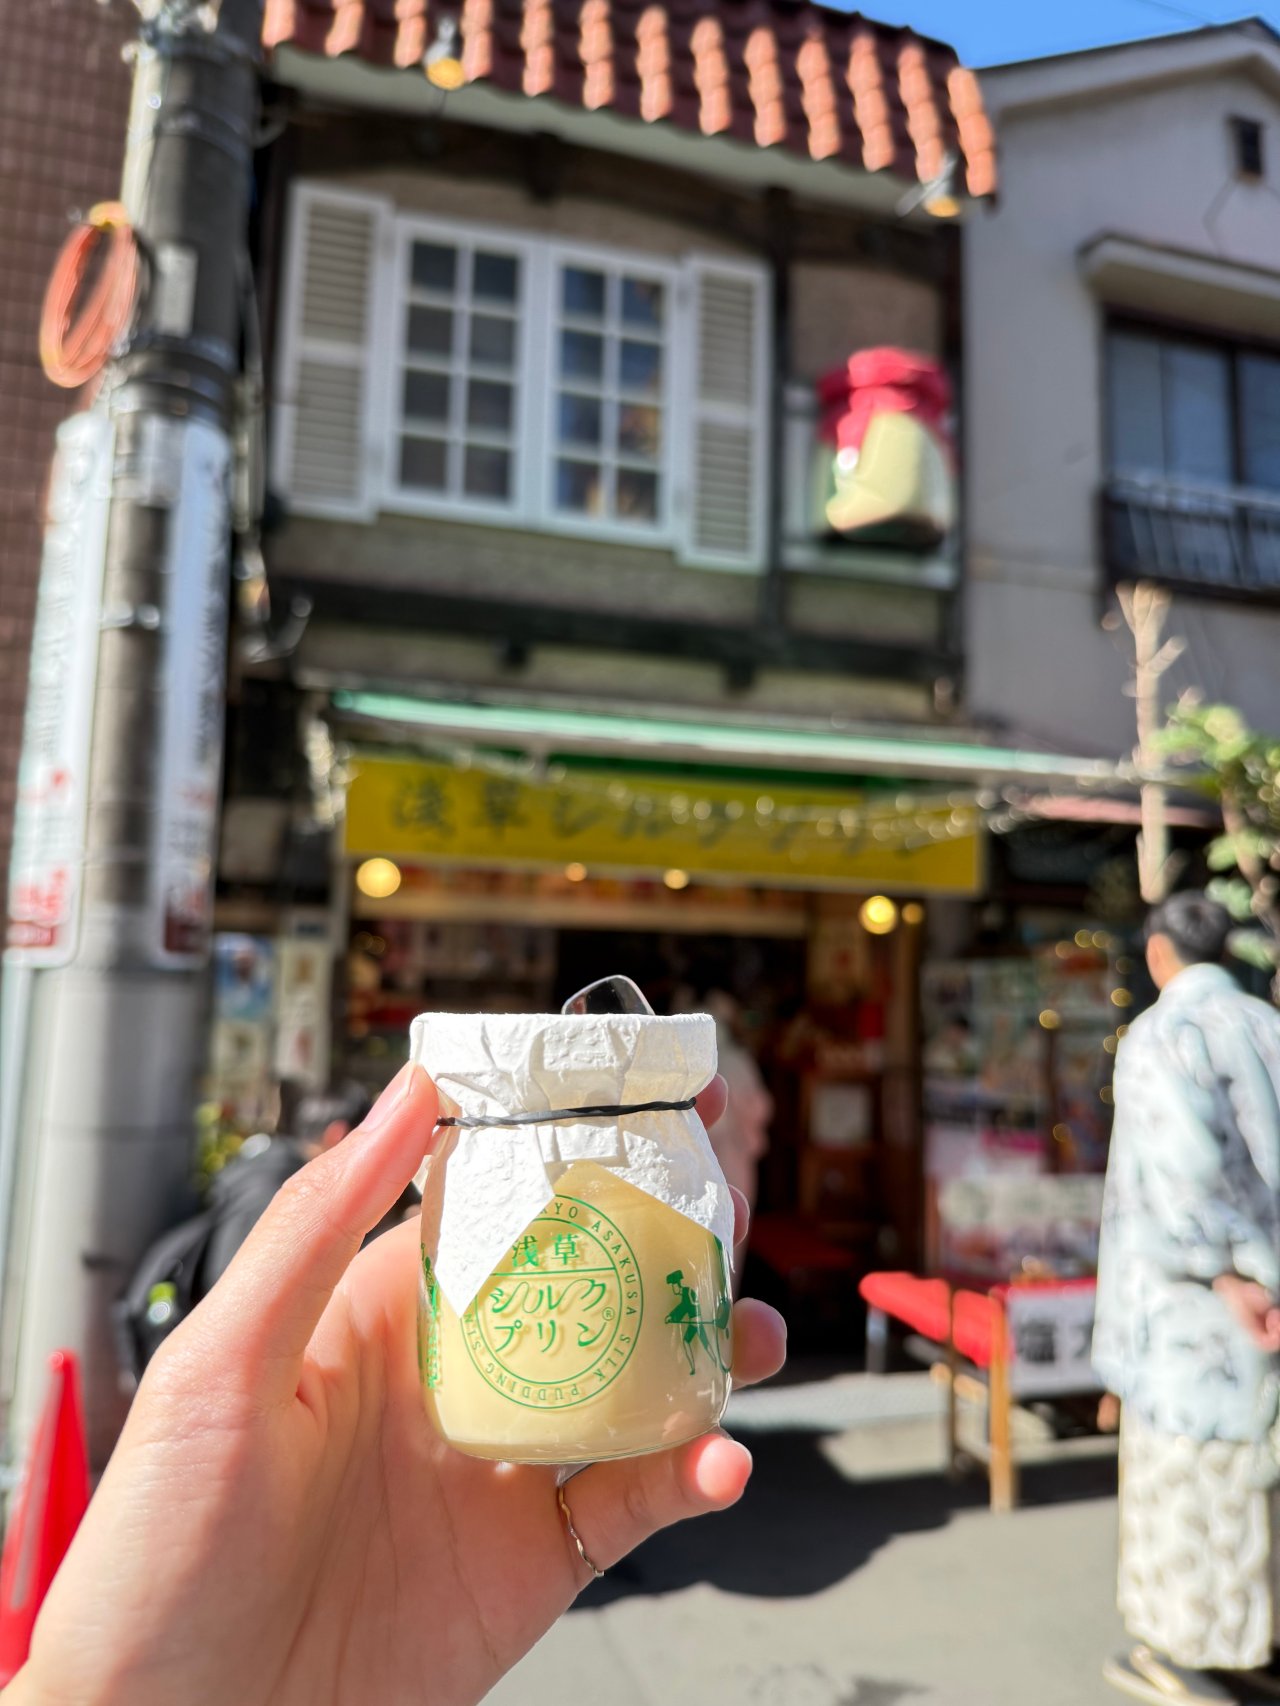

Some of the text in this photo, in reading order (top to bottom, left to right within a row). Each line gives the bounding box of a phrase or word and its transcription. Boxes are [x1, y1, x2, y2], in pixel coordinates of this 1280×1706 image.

[511, 1233, 580, 1268] 浅草
[591, 1220, 638, 1316] ASAKUSA
[489, 1278, 607, 1314] シルク
[463, 1313, 481, 1351] SIN
[493, 1318, 607, 1353] プリン
[593, 1334, 631, 1382] SILK
[485, 1362, 580, 1401] PUDDING
